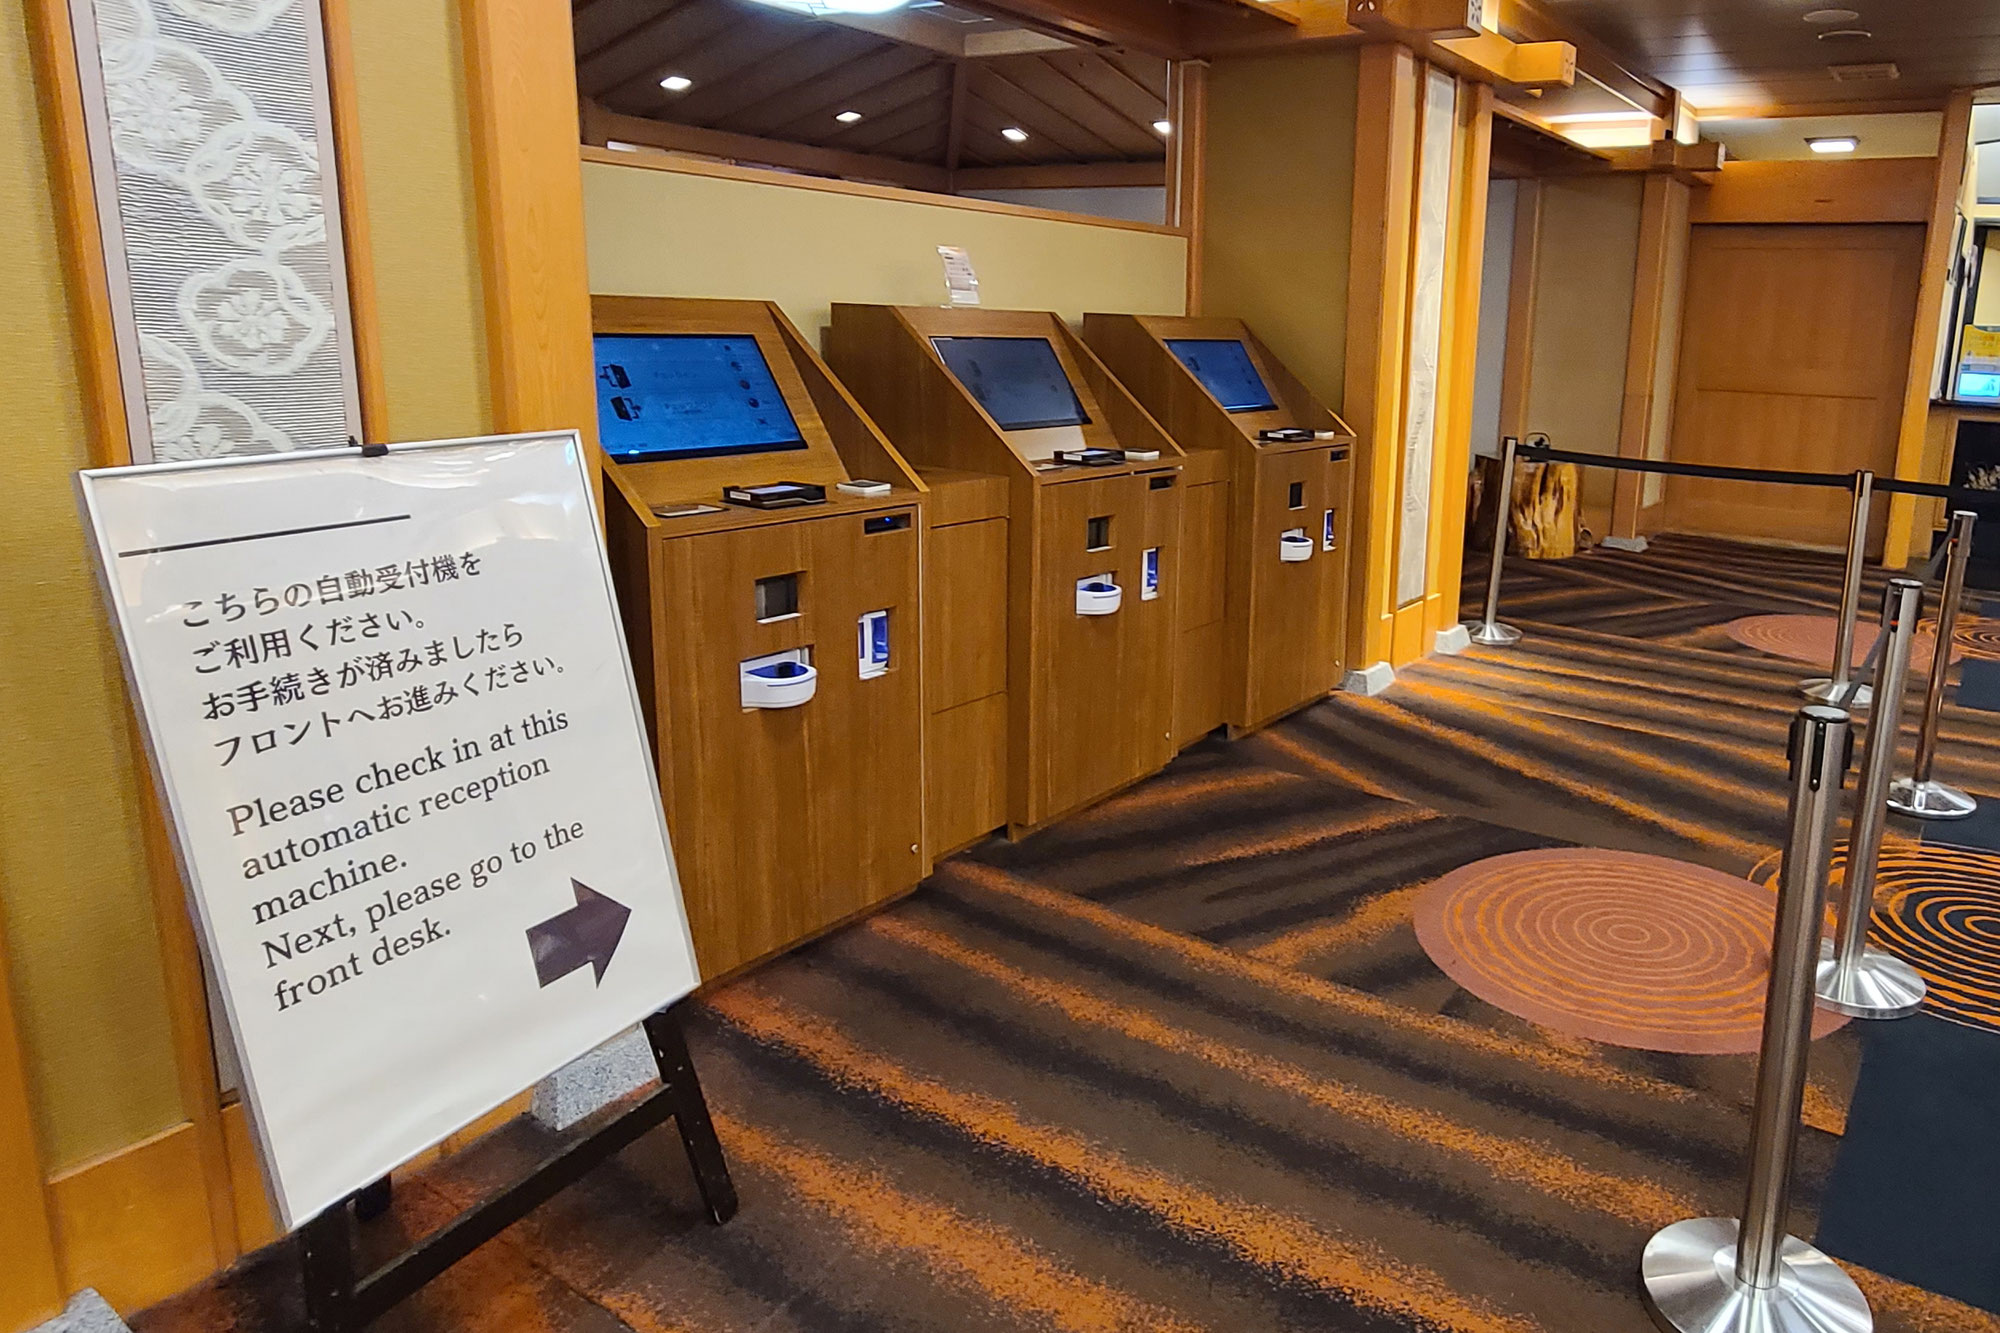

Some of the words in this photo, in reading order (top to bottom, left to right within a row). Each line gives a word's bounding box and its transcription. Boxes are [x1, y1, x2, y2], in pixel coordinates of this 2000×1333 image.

[182, 551, 481, 628] こちらの自動受付機を
[193, 609, 425, 674] ご利用ください。
[202, 623, 524, 720] お手続きが済みましたら
[214, 658, 565, 767] フロントへお進みください。
[226, 780, 344, 836] Please
[355, 745, 446, 794] check
[451, 735, 482, 764] in
[490, 724, 515, 751] at
[521, 710, 569, 741] this
[242, 804, 411, 880] automatic
[420, 756, 550, 818] reception
[252, 851, 407, 924] machine.
[261, 914, 357, 968] Next,
[365, 869, 462, 931] please
[470, 855, 502, 889] go
[510, 841, 536, 864] to
[543, 820, 584, 851] the
[274, 952, 363, 1011] front
[372, 917, 451, 966] desk.
